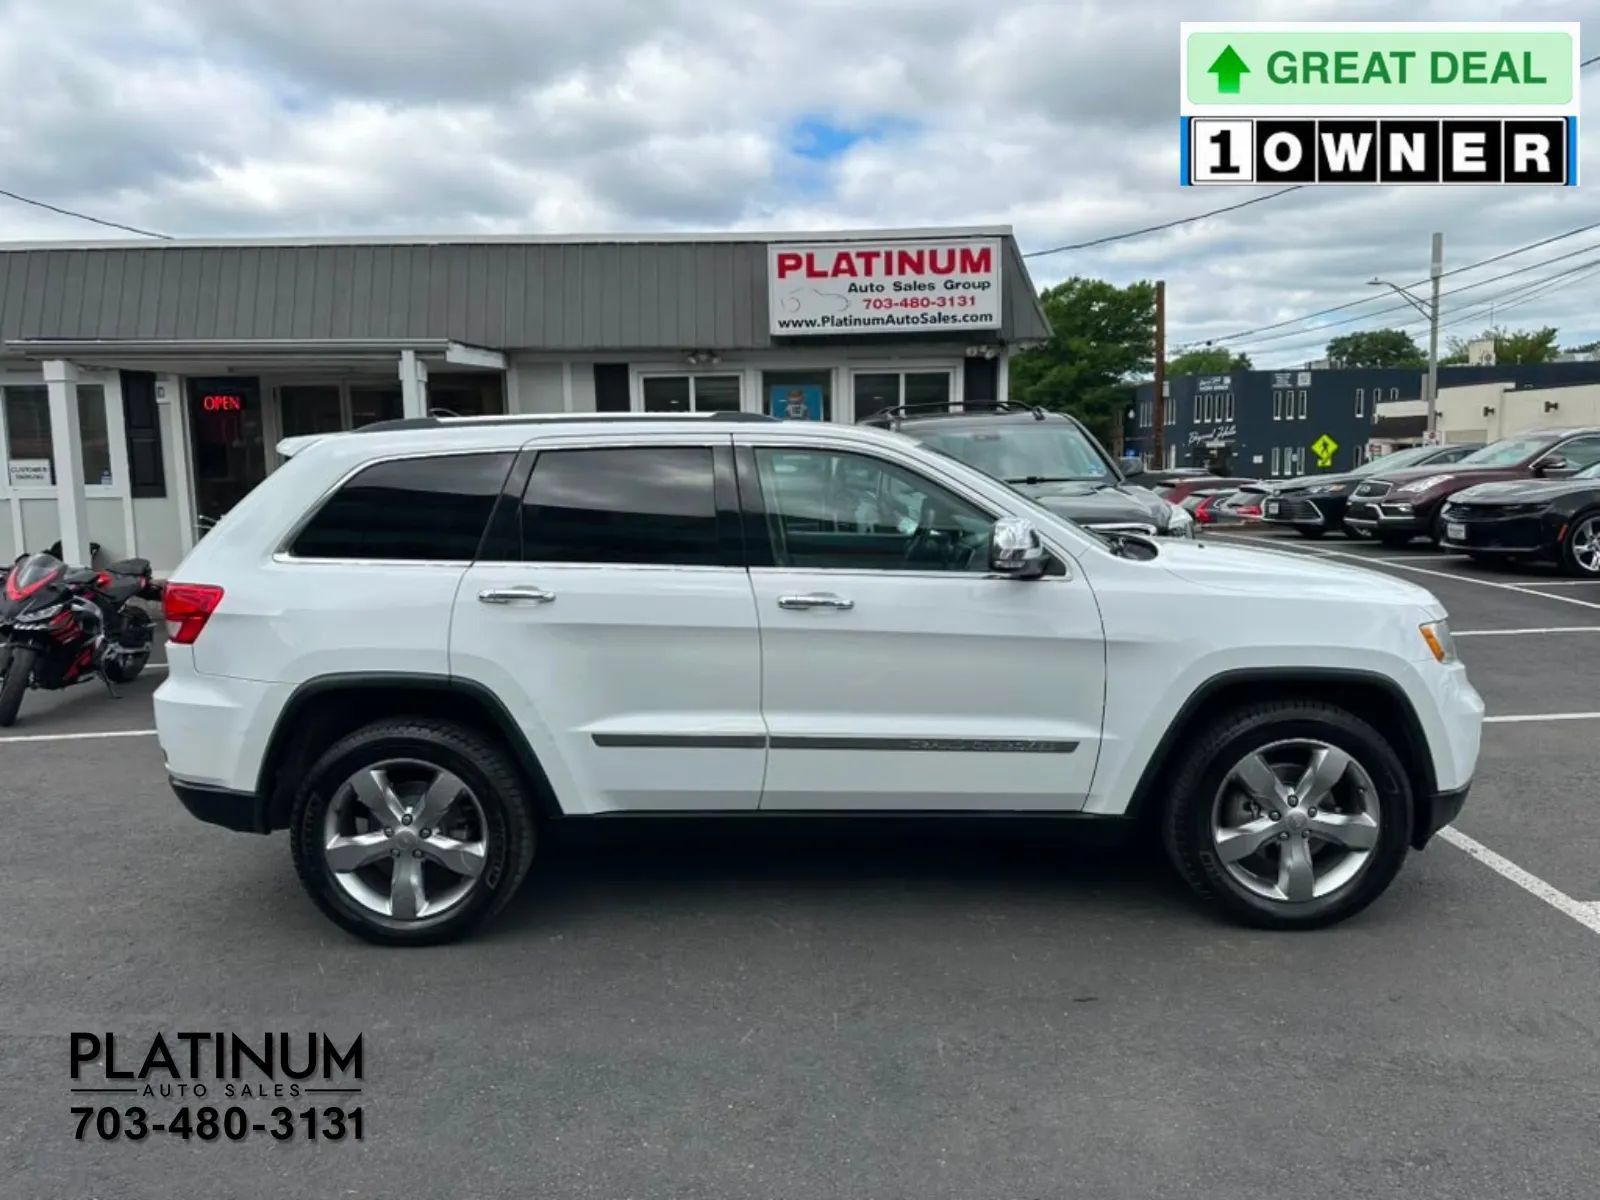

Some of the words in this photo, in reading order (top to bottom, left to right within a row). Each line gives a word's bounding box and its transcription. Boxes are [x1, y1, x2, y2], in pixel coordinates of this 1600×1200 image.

[777, 247, 991, 279] PLATINUM
[848, 281, 885, 293] Auto
[893, 280, 936, 292] Sales
[943, 279, 991, 292] Group
[862, 295, 977, 310] 703-480-3131
[778, 311, 993, 329] www.PlatinumAutoSales.com
[203, 395, 240, 410] OPEN
